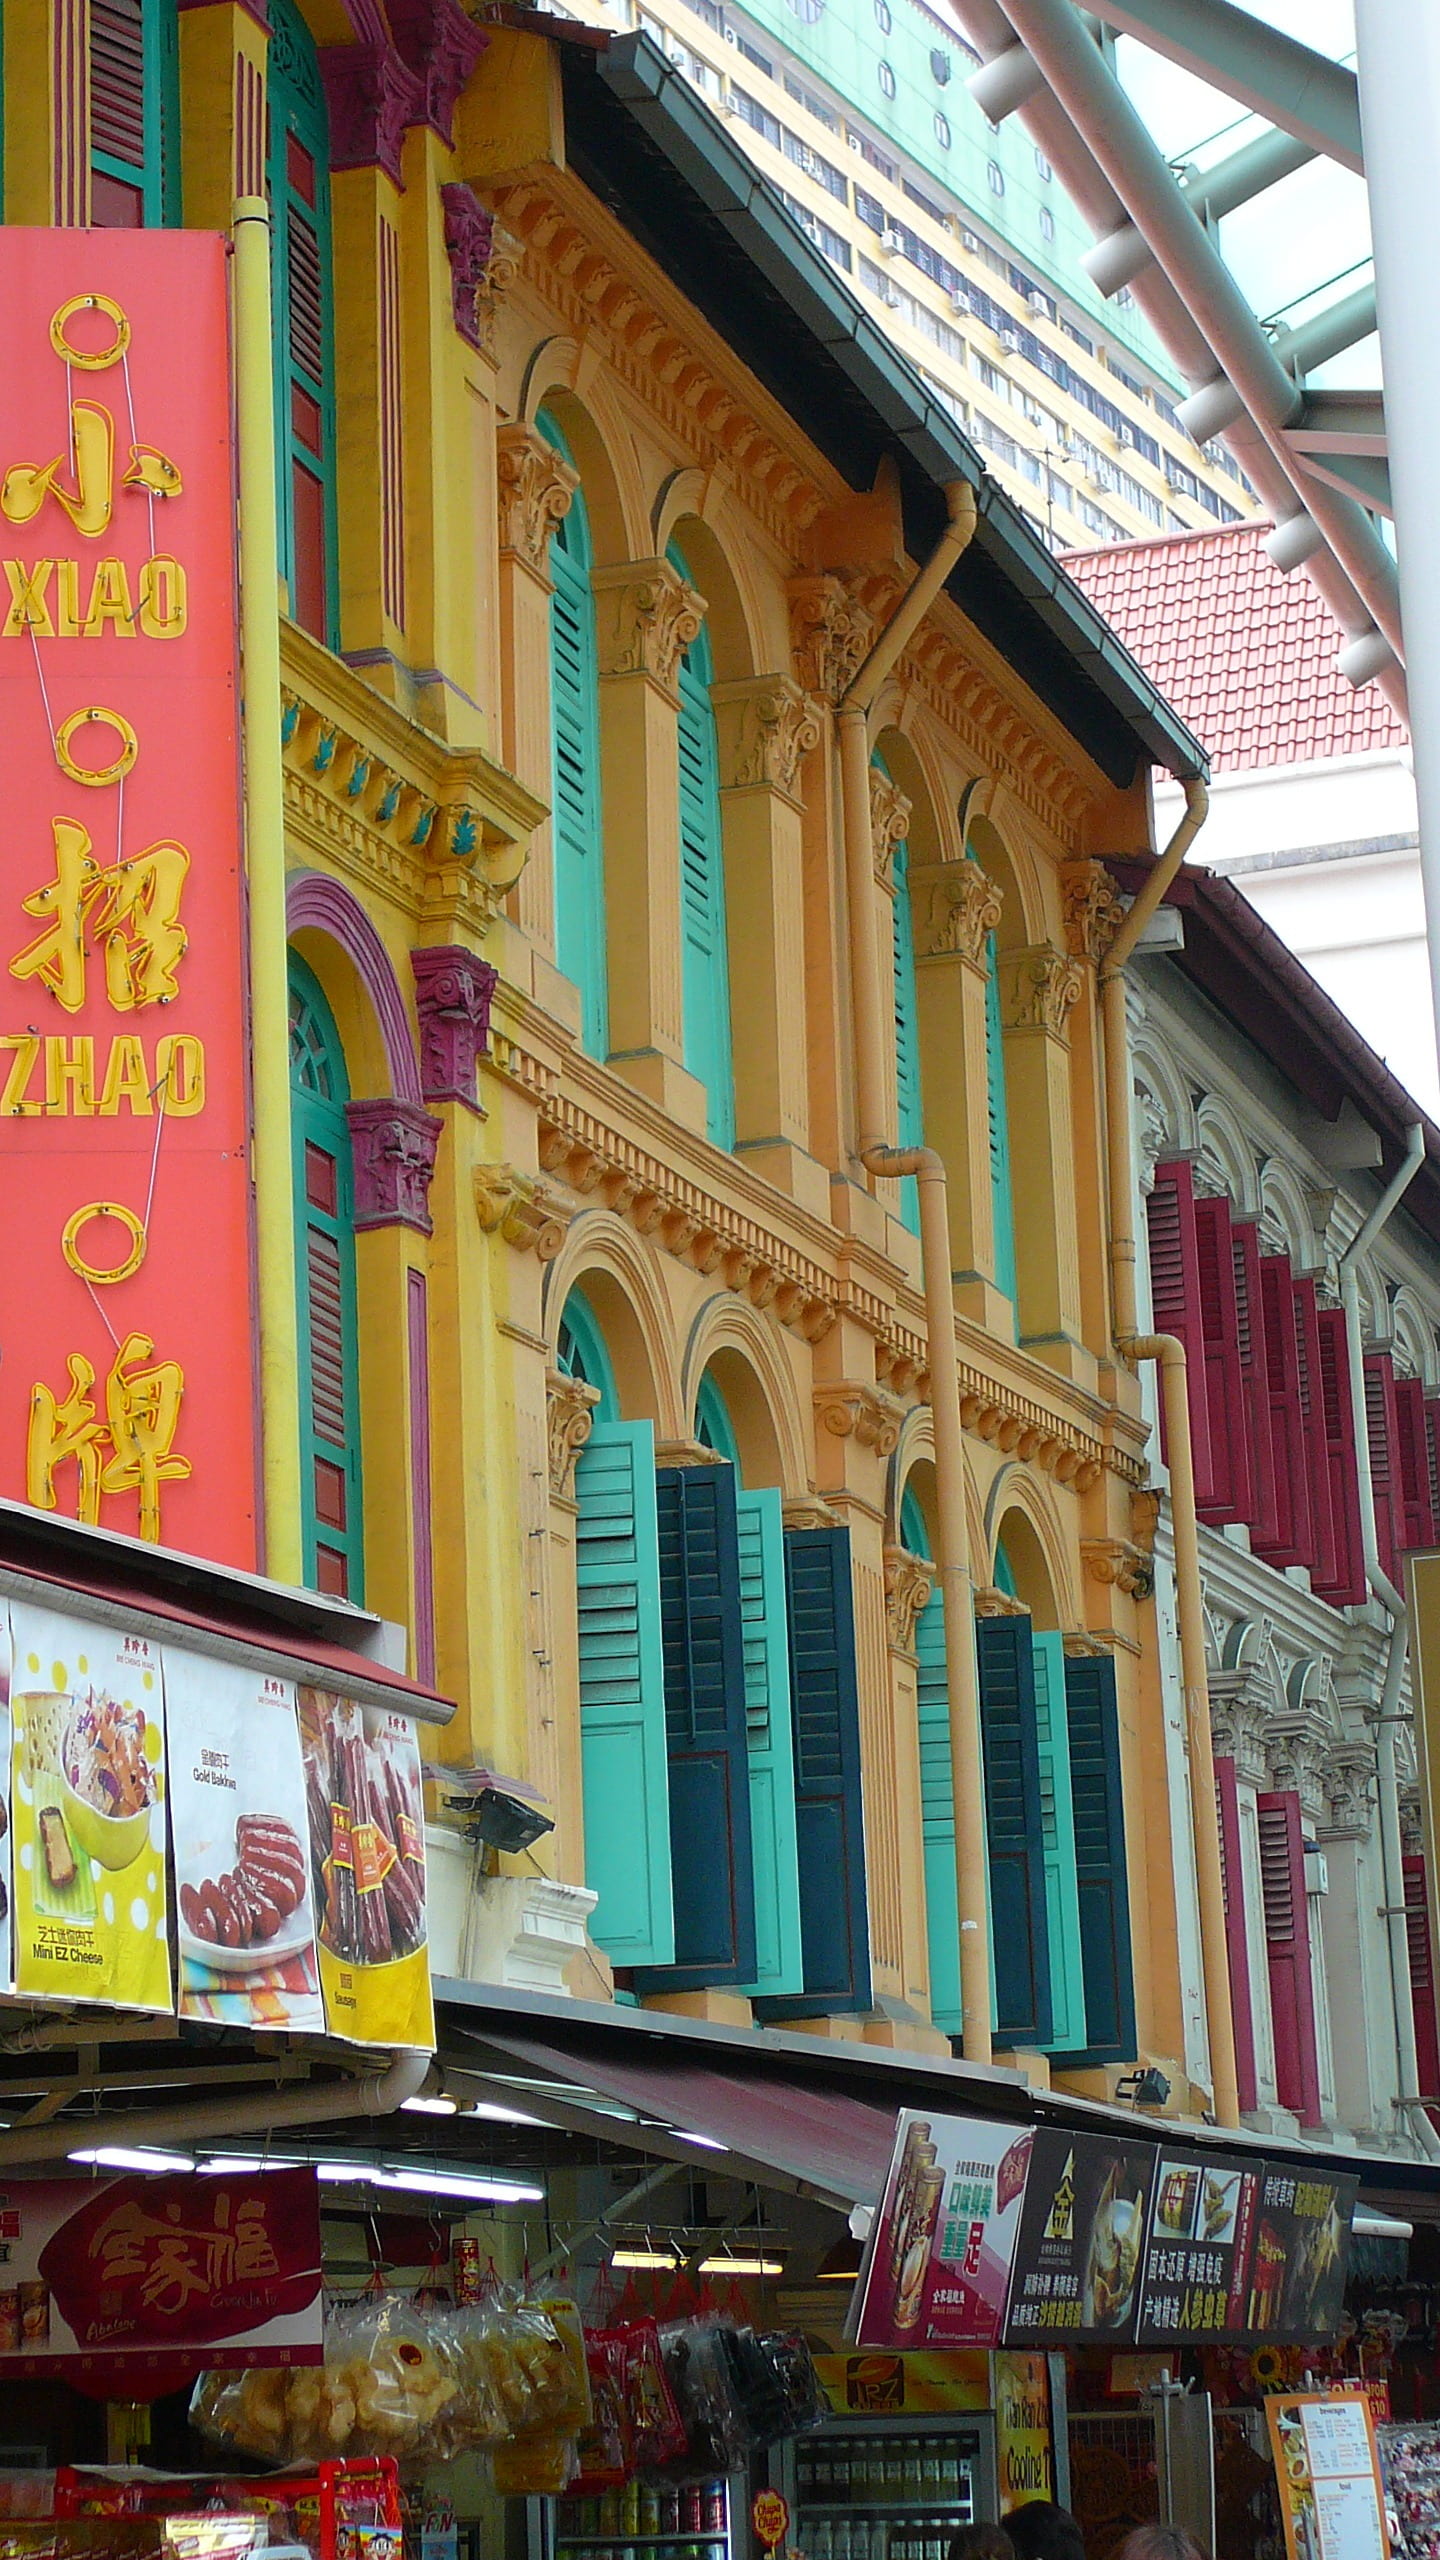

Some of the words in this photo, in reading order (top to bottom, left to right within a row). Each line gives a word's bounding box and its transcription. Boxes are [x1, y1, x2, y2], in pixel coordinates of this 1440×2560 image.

[1, 399, 182, 538] 小
[2, 554, 188, 639] XIAO
[8, 816, 191, 1013] 招
[0, 1034, 205, 1117] ZHAO
[193, 1767, 210, 1784] Gold
[33, 1944, 53, 1960] Mini
[55, 1946, 68, 1961] EZ
[70, 1948, 104, 1965] Cheese
[949, 2182, 994, 2219] 口味鲜美
[1148, 2249, 1186, 2282] 固本还原
[1187, 2252, 1224, 2285] 增强免疫
[86, 2318, 137, 2342] Abalone
[1327, 2384, 1354, 2393] OR
[1319, 2407, 1347, 2416] beverages
[757, 2503, 781, 2518] Chupa
